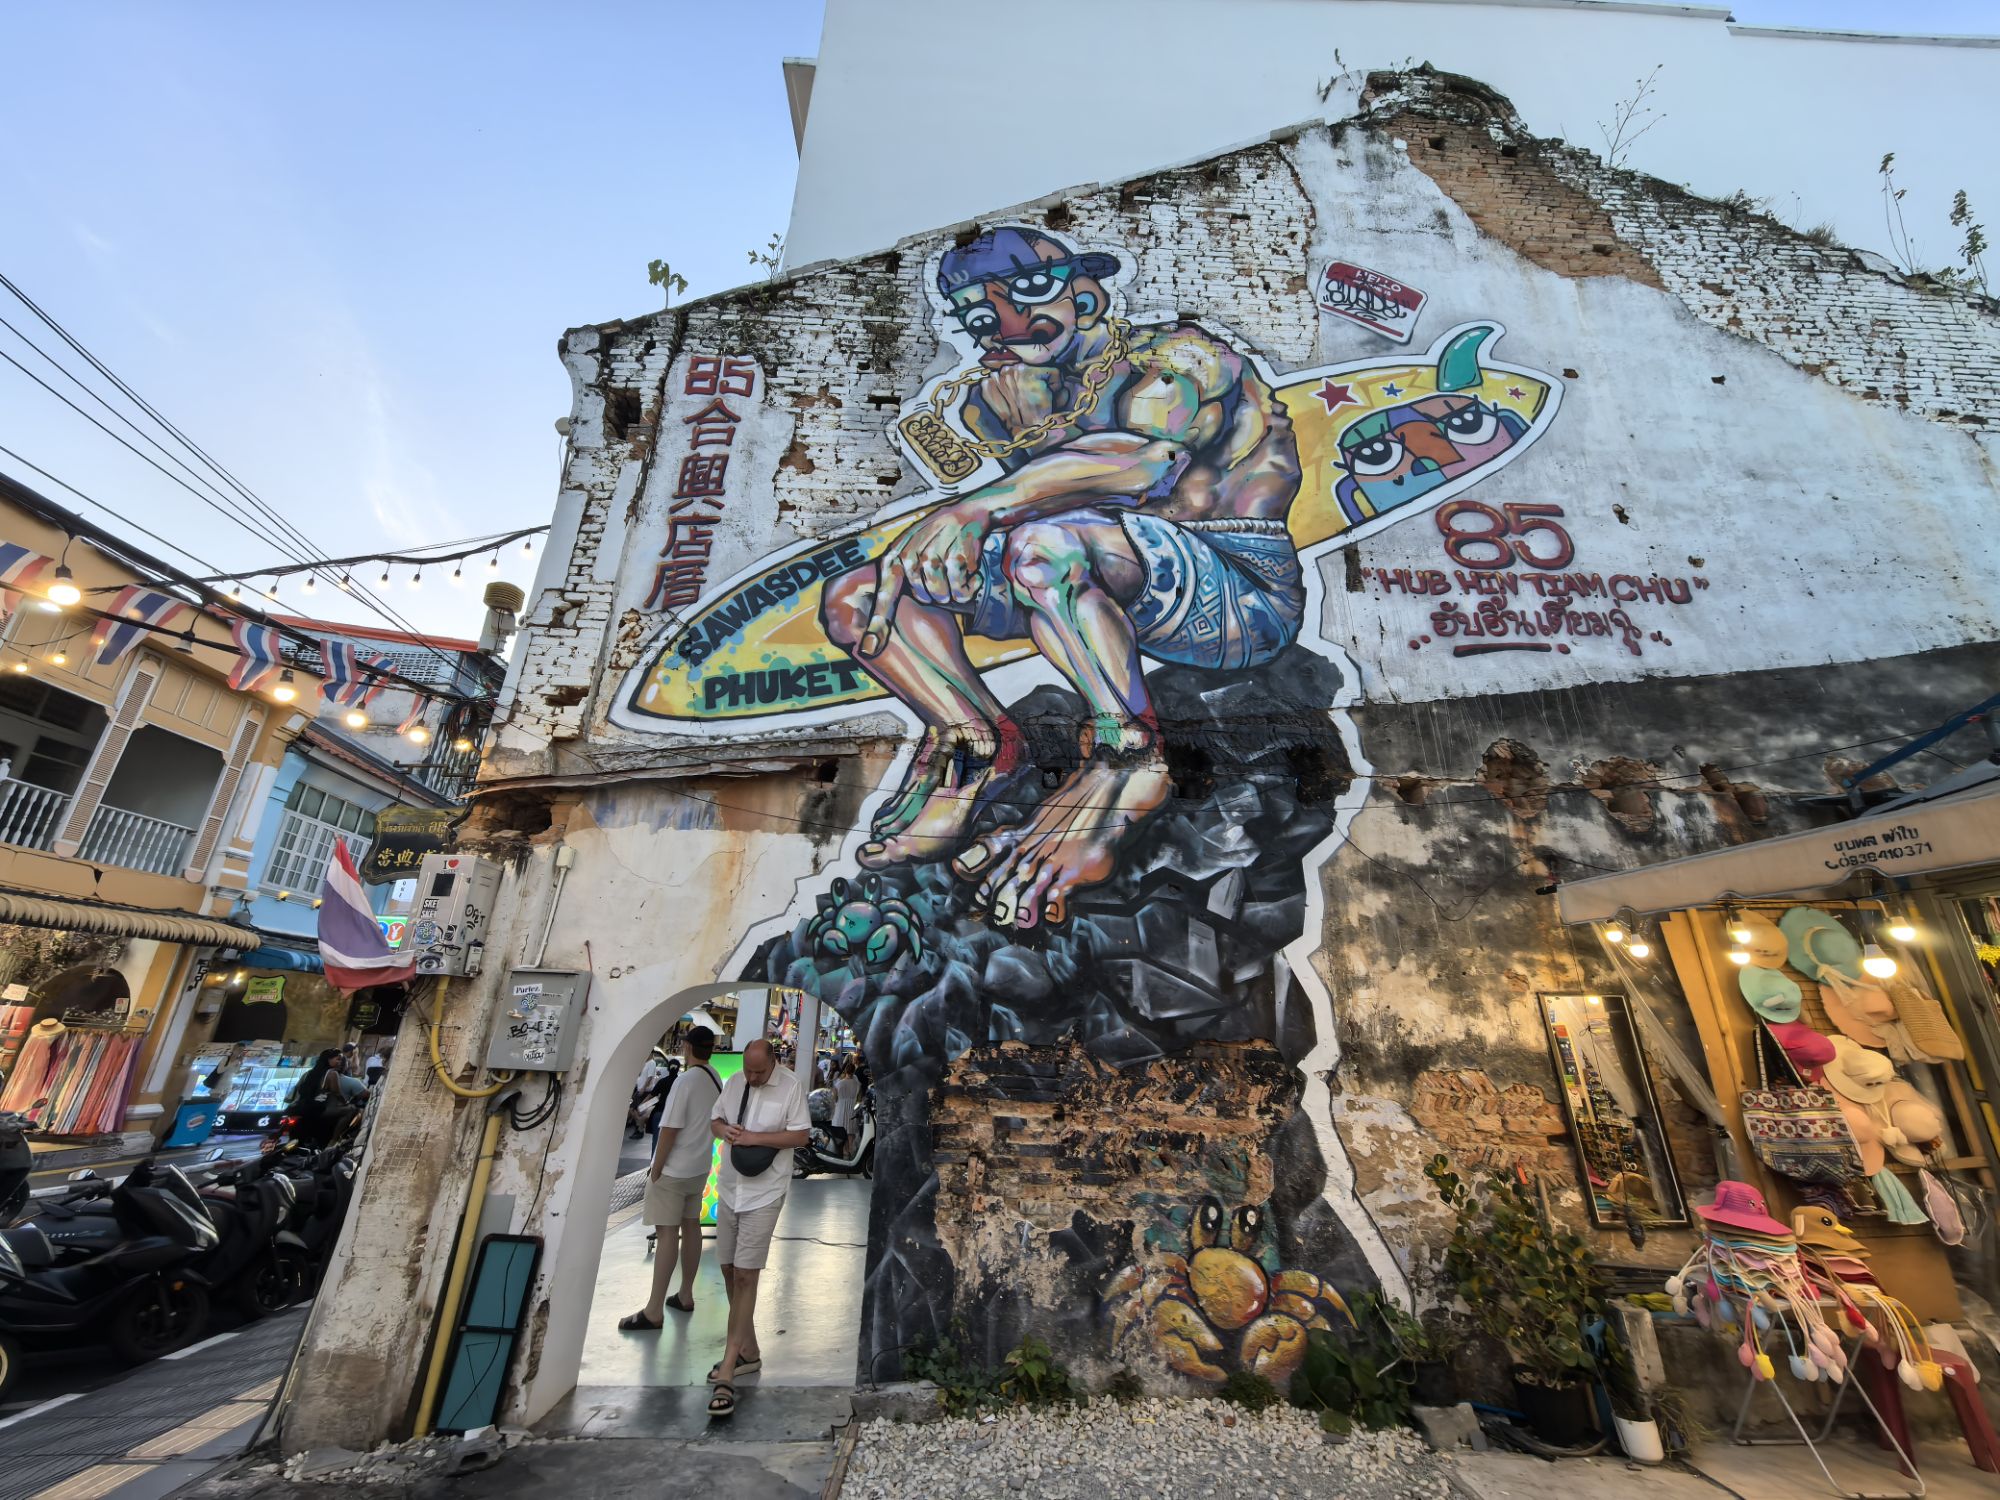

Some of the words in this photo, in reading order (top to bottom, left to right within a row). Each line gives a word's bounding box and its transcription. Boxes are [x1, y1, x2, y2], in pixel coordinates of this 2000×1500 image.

[684, 356, 755, 397] 85
[1435, 500, 1575, 570] 85
[678, 539, 866, 667] SAWASDEE
[1454, 569, 1518, 596] HIN
[1520, 572, 1608, 598] TIAM
[704, 659, 860, 710] PHUKET
